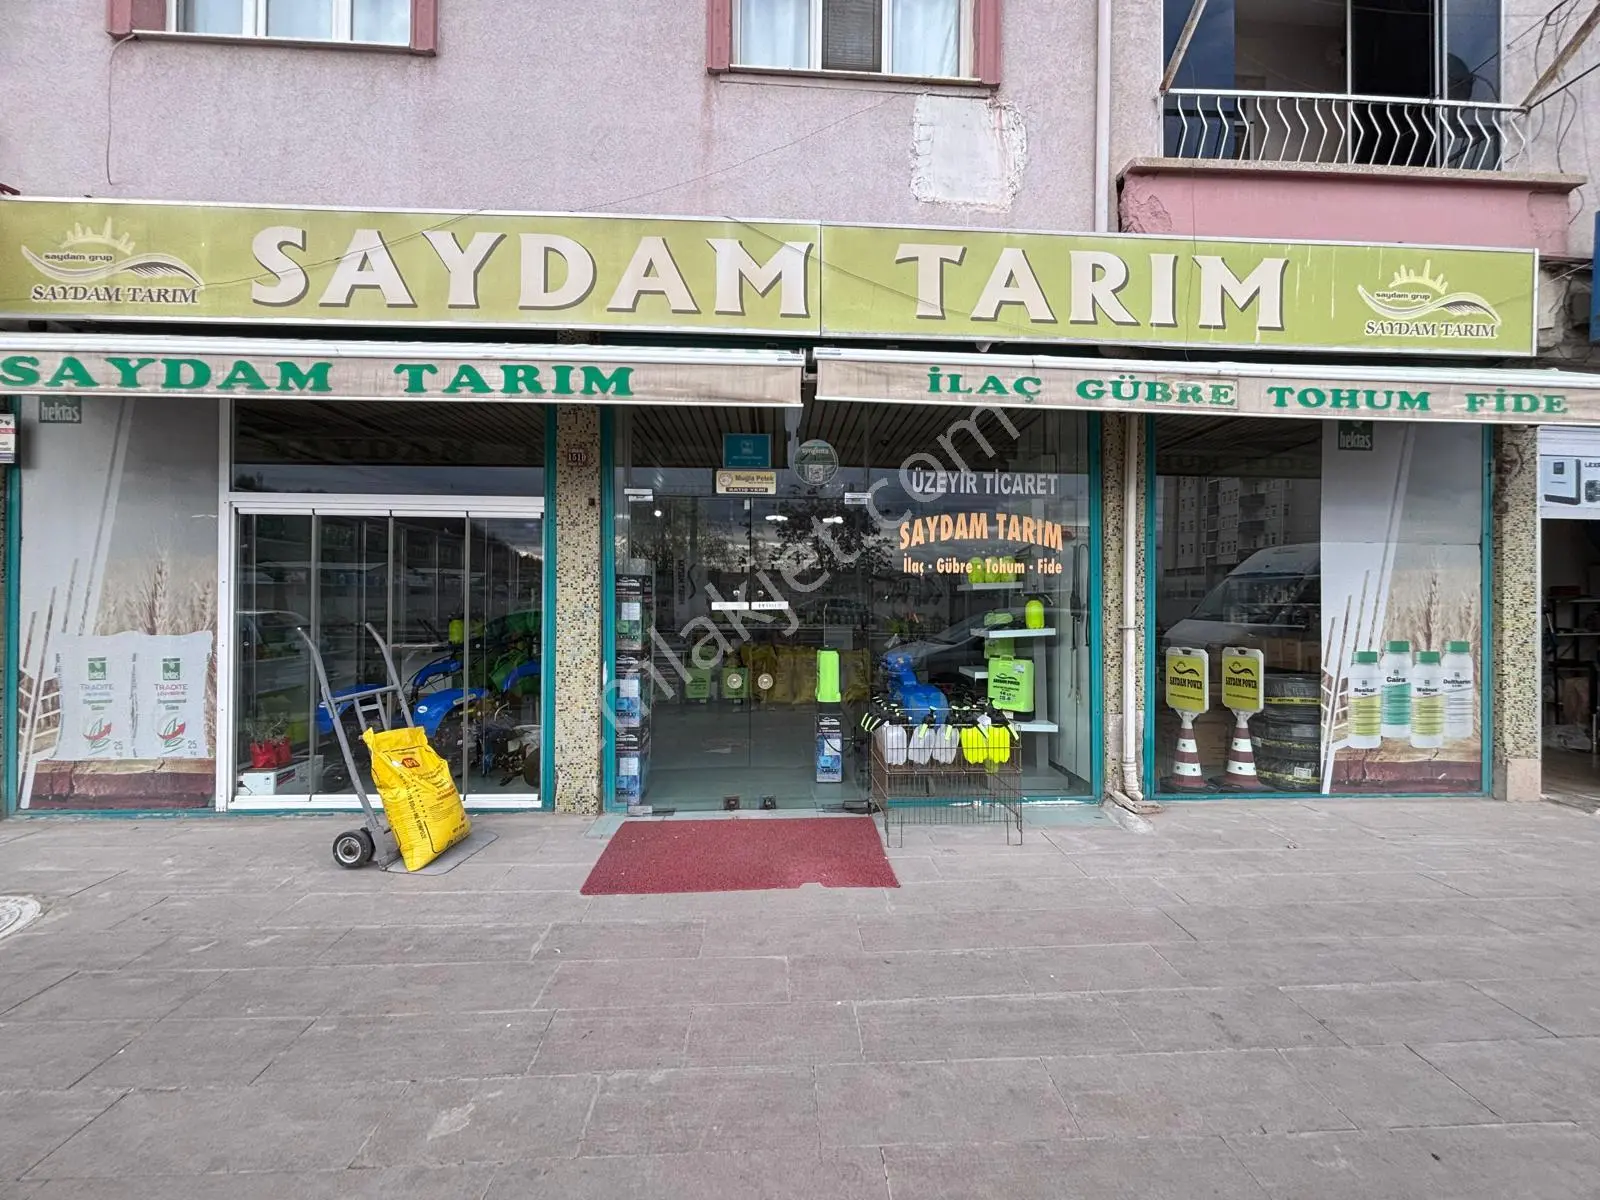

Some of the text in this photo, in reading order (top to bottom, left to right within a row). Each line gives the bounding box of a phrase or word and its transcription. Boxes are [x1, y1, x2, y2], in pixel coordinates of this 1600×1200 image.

[44, 253, 86, 262] saydam
[250, 225, 1289, 331] SAYDAM TARIM
[31, 286, 198, 304] SAYDAM TARIM
[1376, 292, 1409, 300] saydam
[1365, 321, 1497, 337] SAYDAM TARIM
[0, 356, 636, 397] SAYDAM TARIM
[927, 366, 1569, 415] İLAÇ GÜBRE TOHUM FİDE
[912, 467, 1058, 495] ÜZEYİR TİCARET
[899, 512, 1063, 551] SAYDAM TARIM
[903, 552, 1063, 578] İlaç Gübre Tohum Fide
[188, 740, 198, 749] 25
